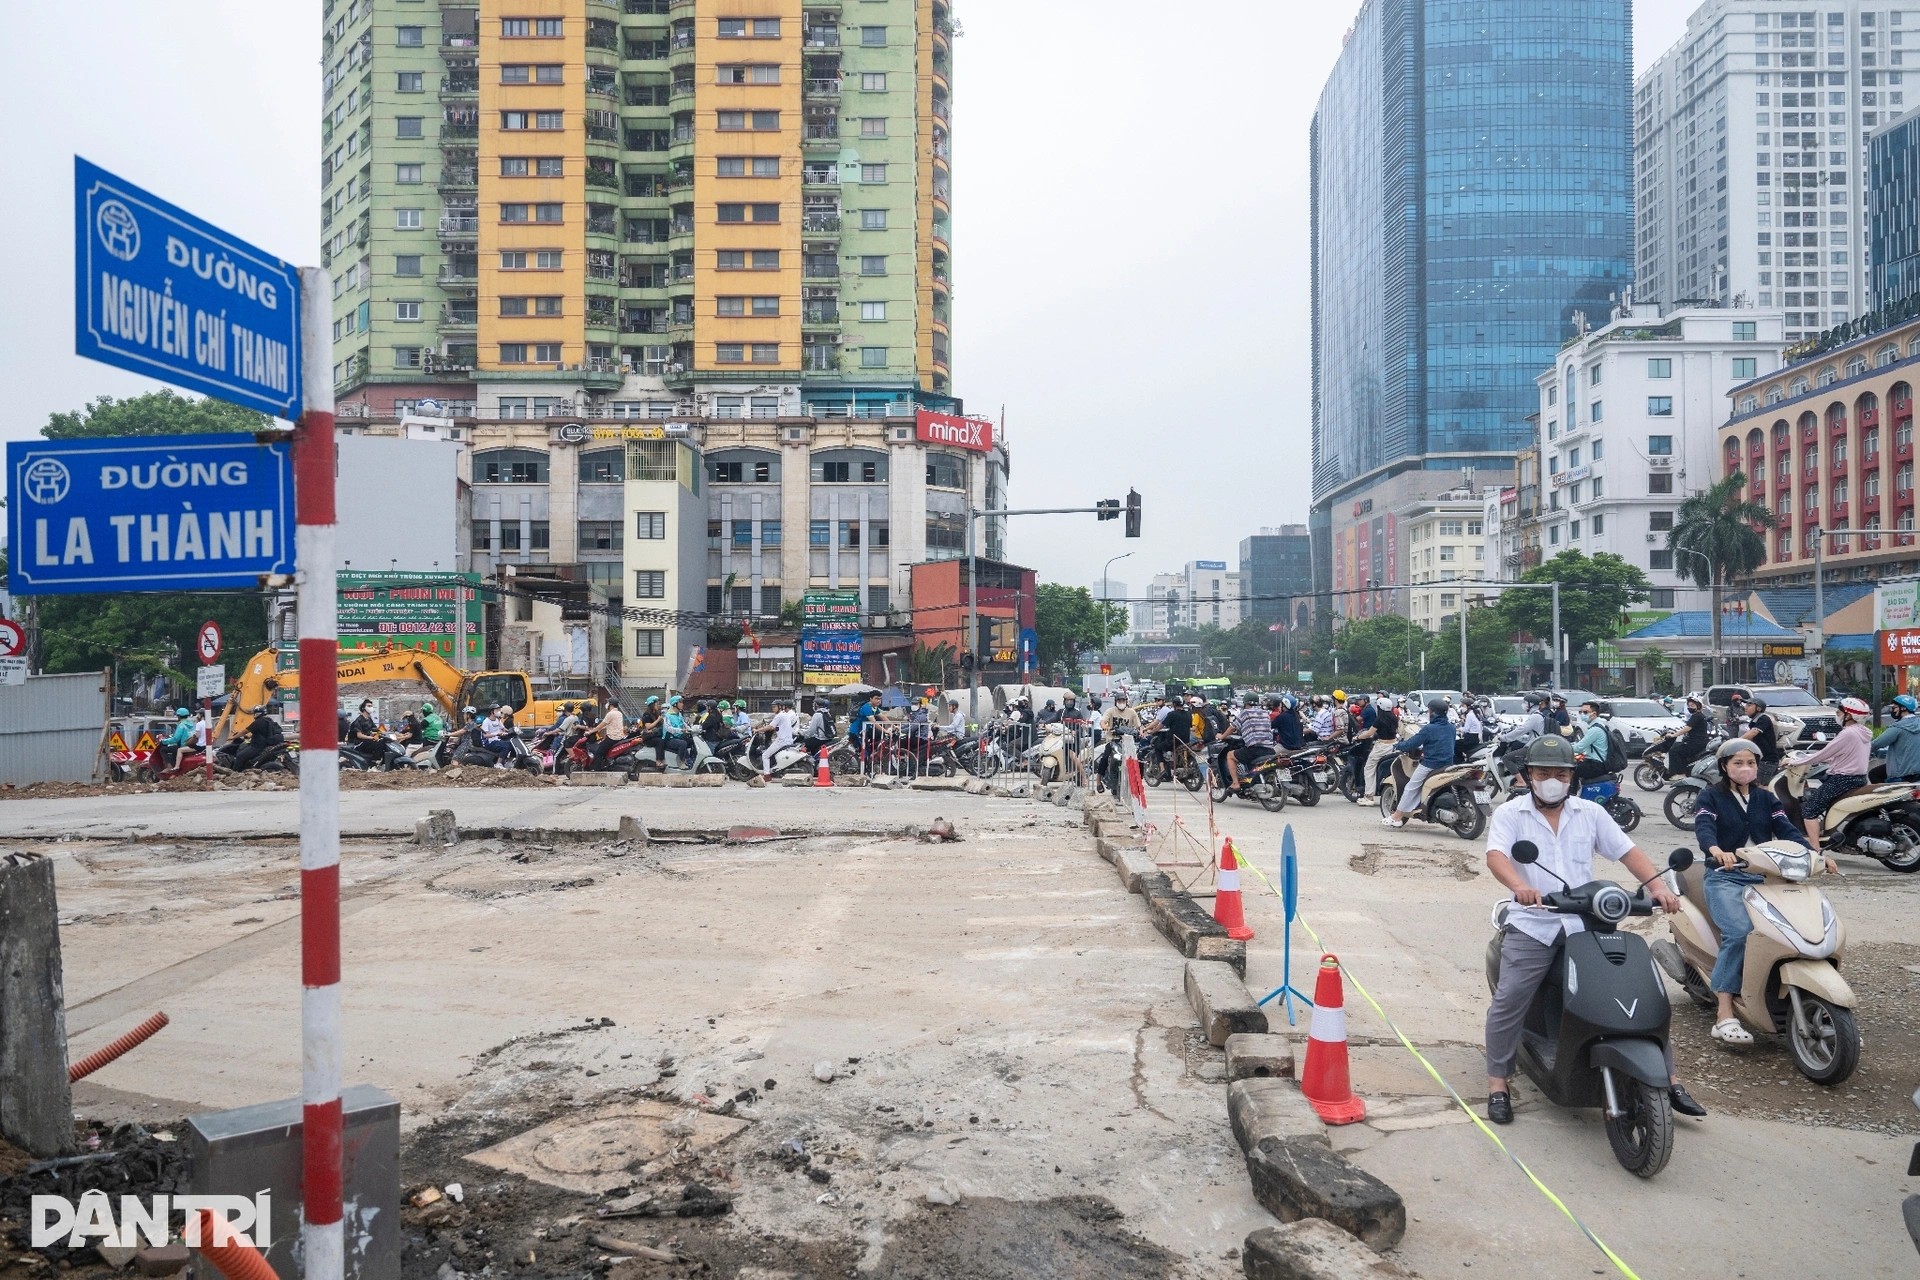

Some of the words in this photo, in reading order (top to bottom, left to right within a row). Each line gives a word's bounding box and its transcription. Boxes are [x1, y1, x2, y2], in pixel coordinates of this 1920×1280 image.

[166, 234, 278, 310] ĐƯỜNG
[102, 270, 188, 359] NGUYỄN
[195, 308, 227, 371] CHÍ
[232, 324, 289, 394] THANH
[929, 420, 983, 446] mindX
[99, 455, 248, 490] ĐƯỜNG
[35, 517, 94, 567] LA
[110, 501, 274, 563] THÀNH
[390, 588, 432, 600] PHUN
[379, 622, 397, 633] ĐT:
[383, 663, 395, 672] X24
